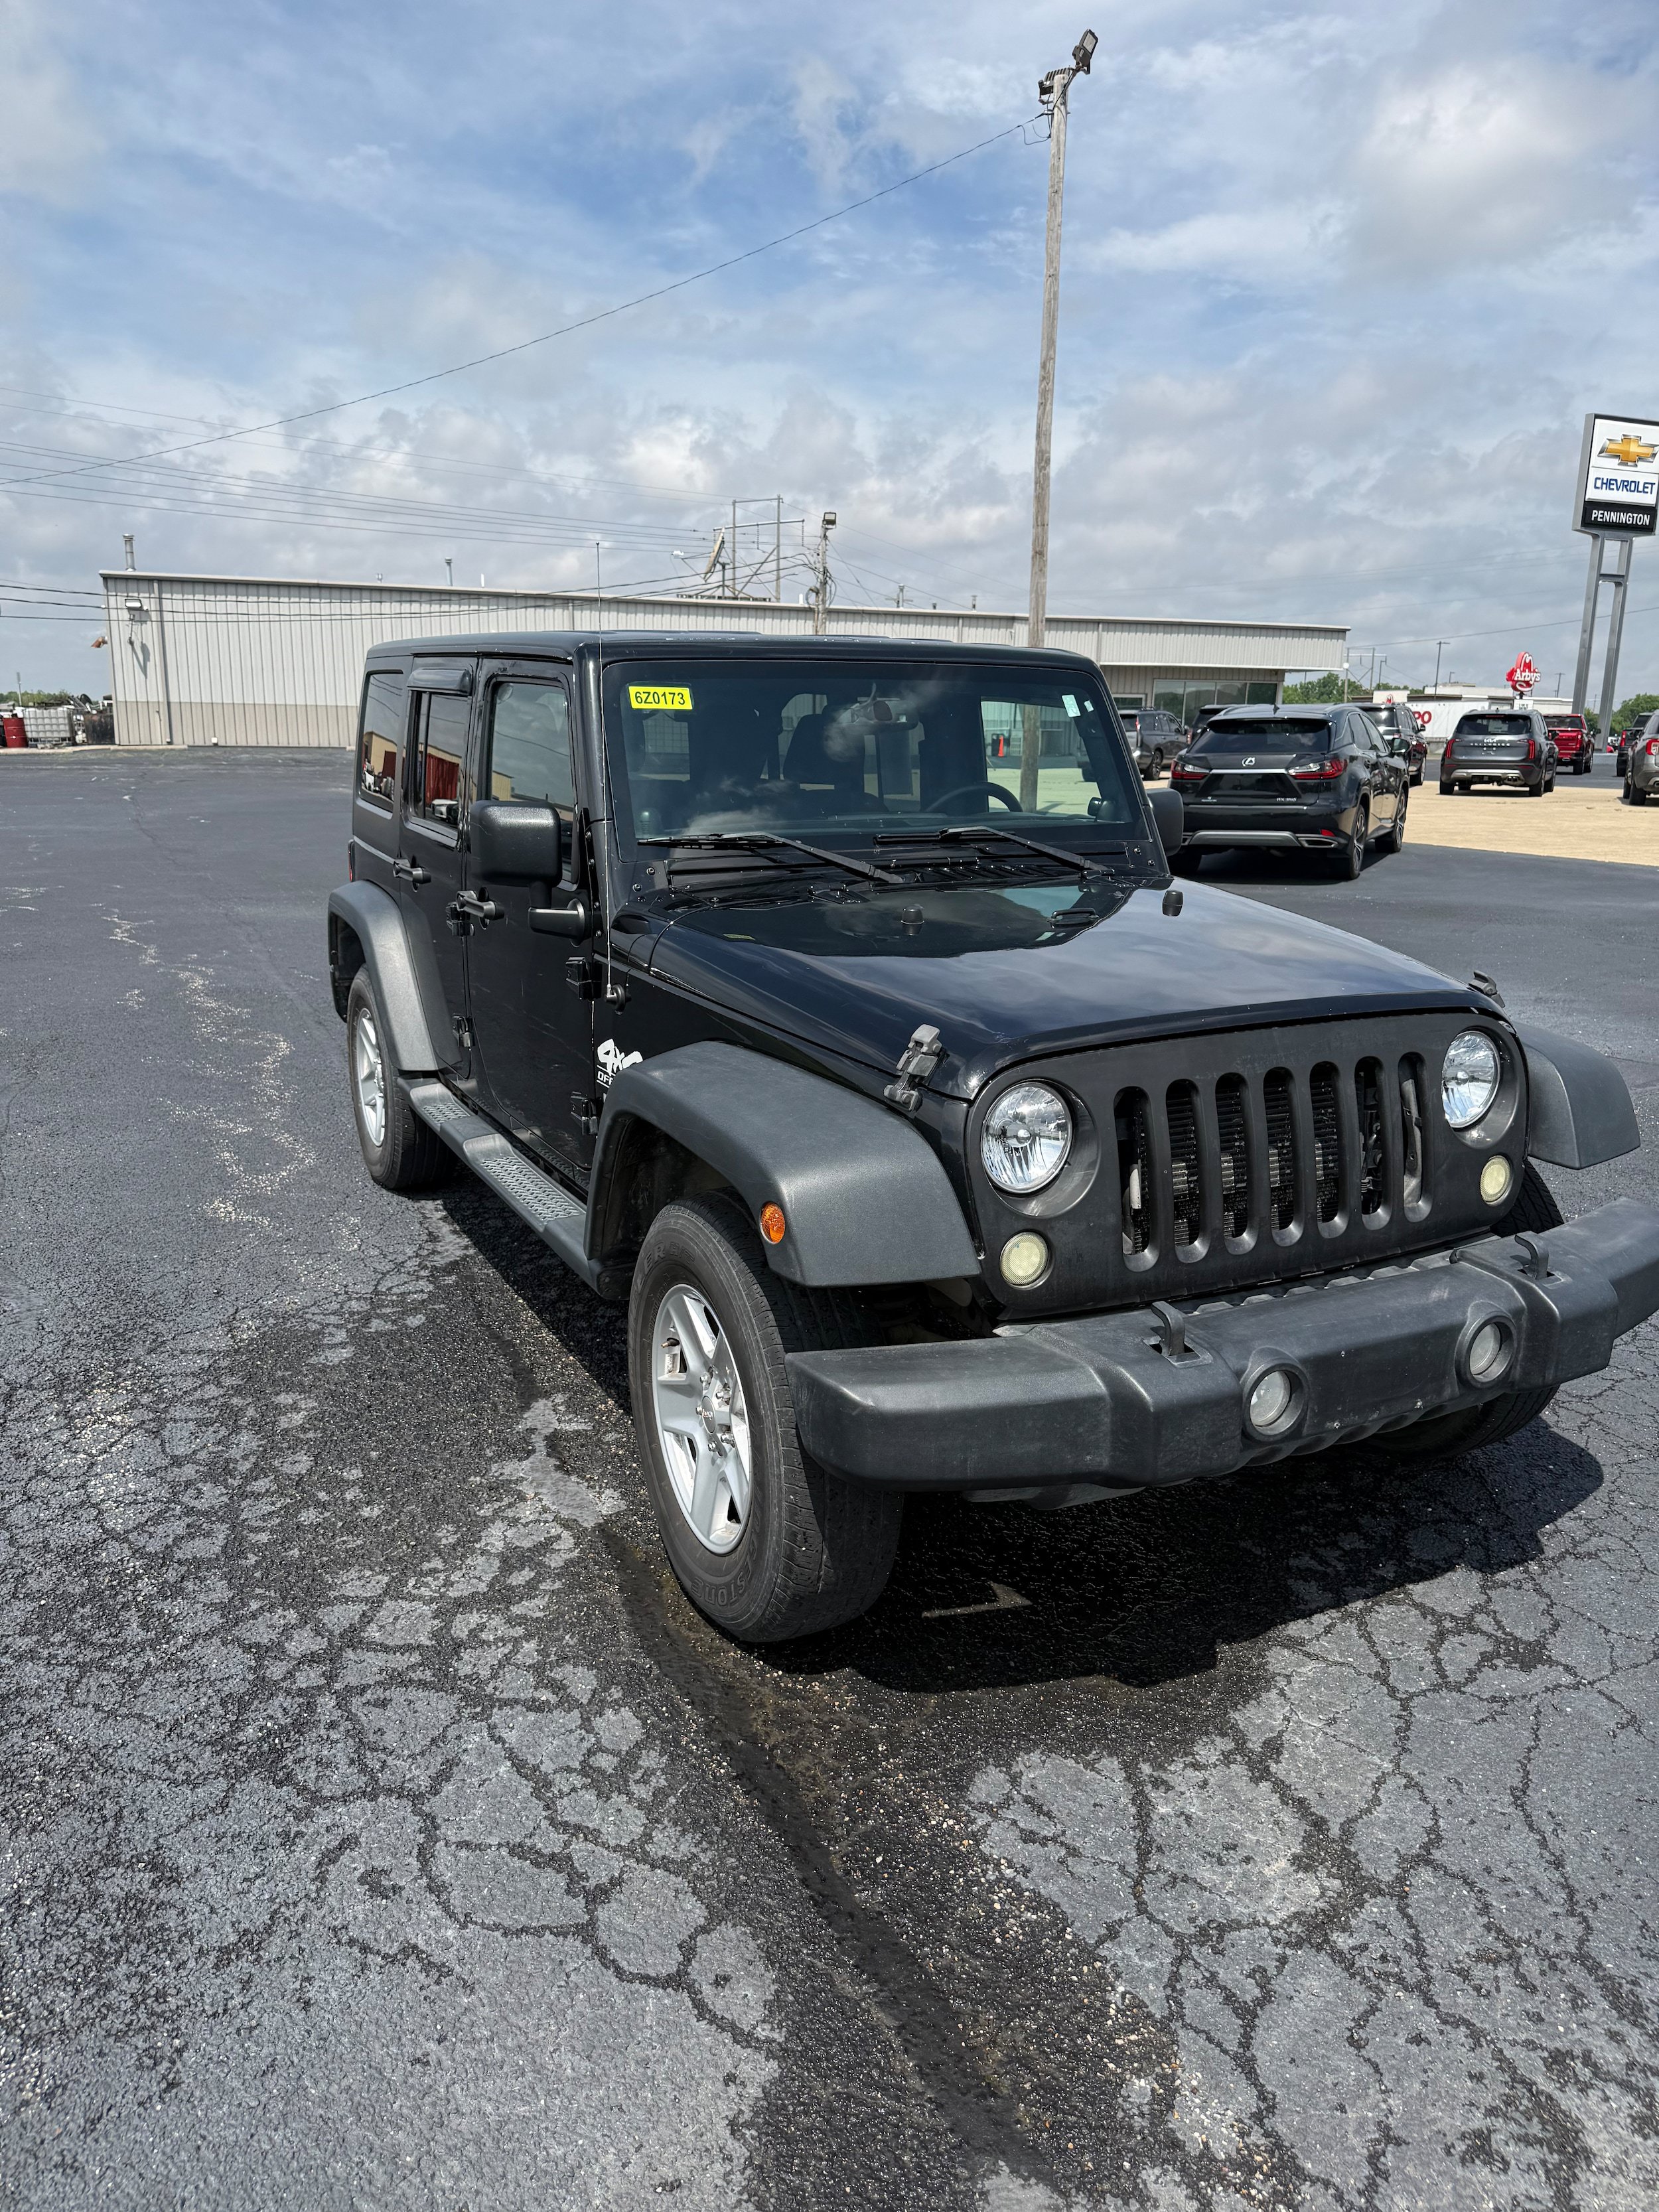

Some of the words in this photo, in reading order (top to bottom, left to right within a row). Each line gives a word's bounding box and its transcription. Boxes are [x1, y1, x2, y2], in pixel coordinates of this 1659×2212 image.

[1593, 477, 1656, 494] CHEVROLET
[1591, 510, 1650, 526] PENNINGTON
[1514, 668, 1541, 684] Arby's
[634, 691, 685, 705] 6Z0173
